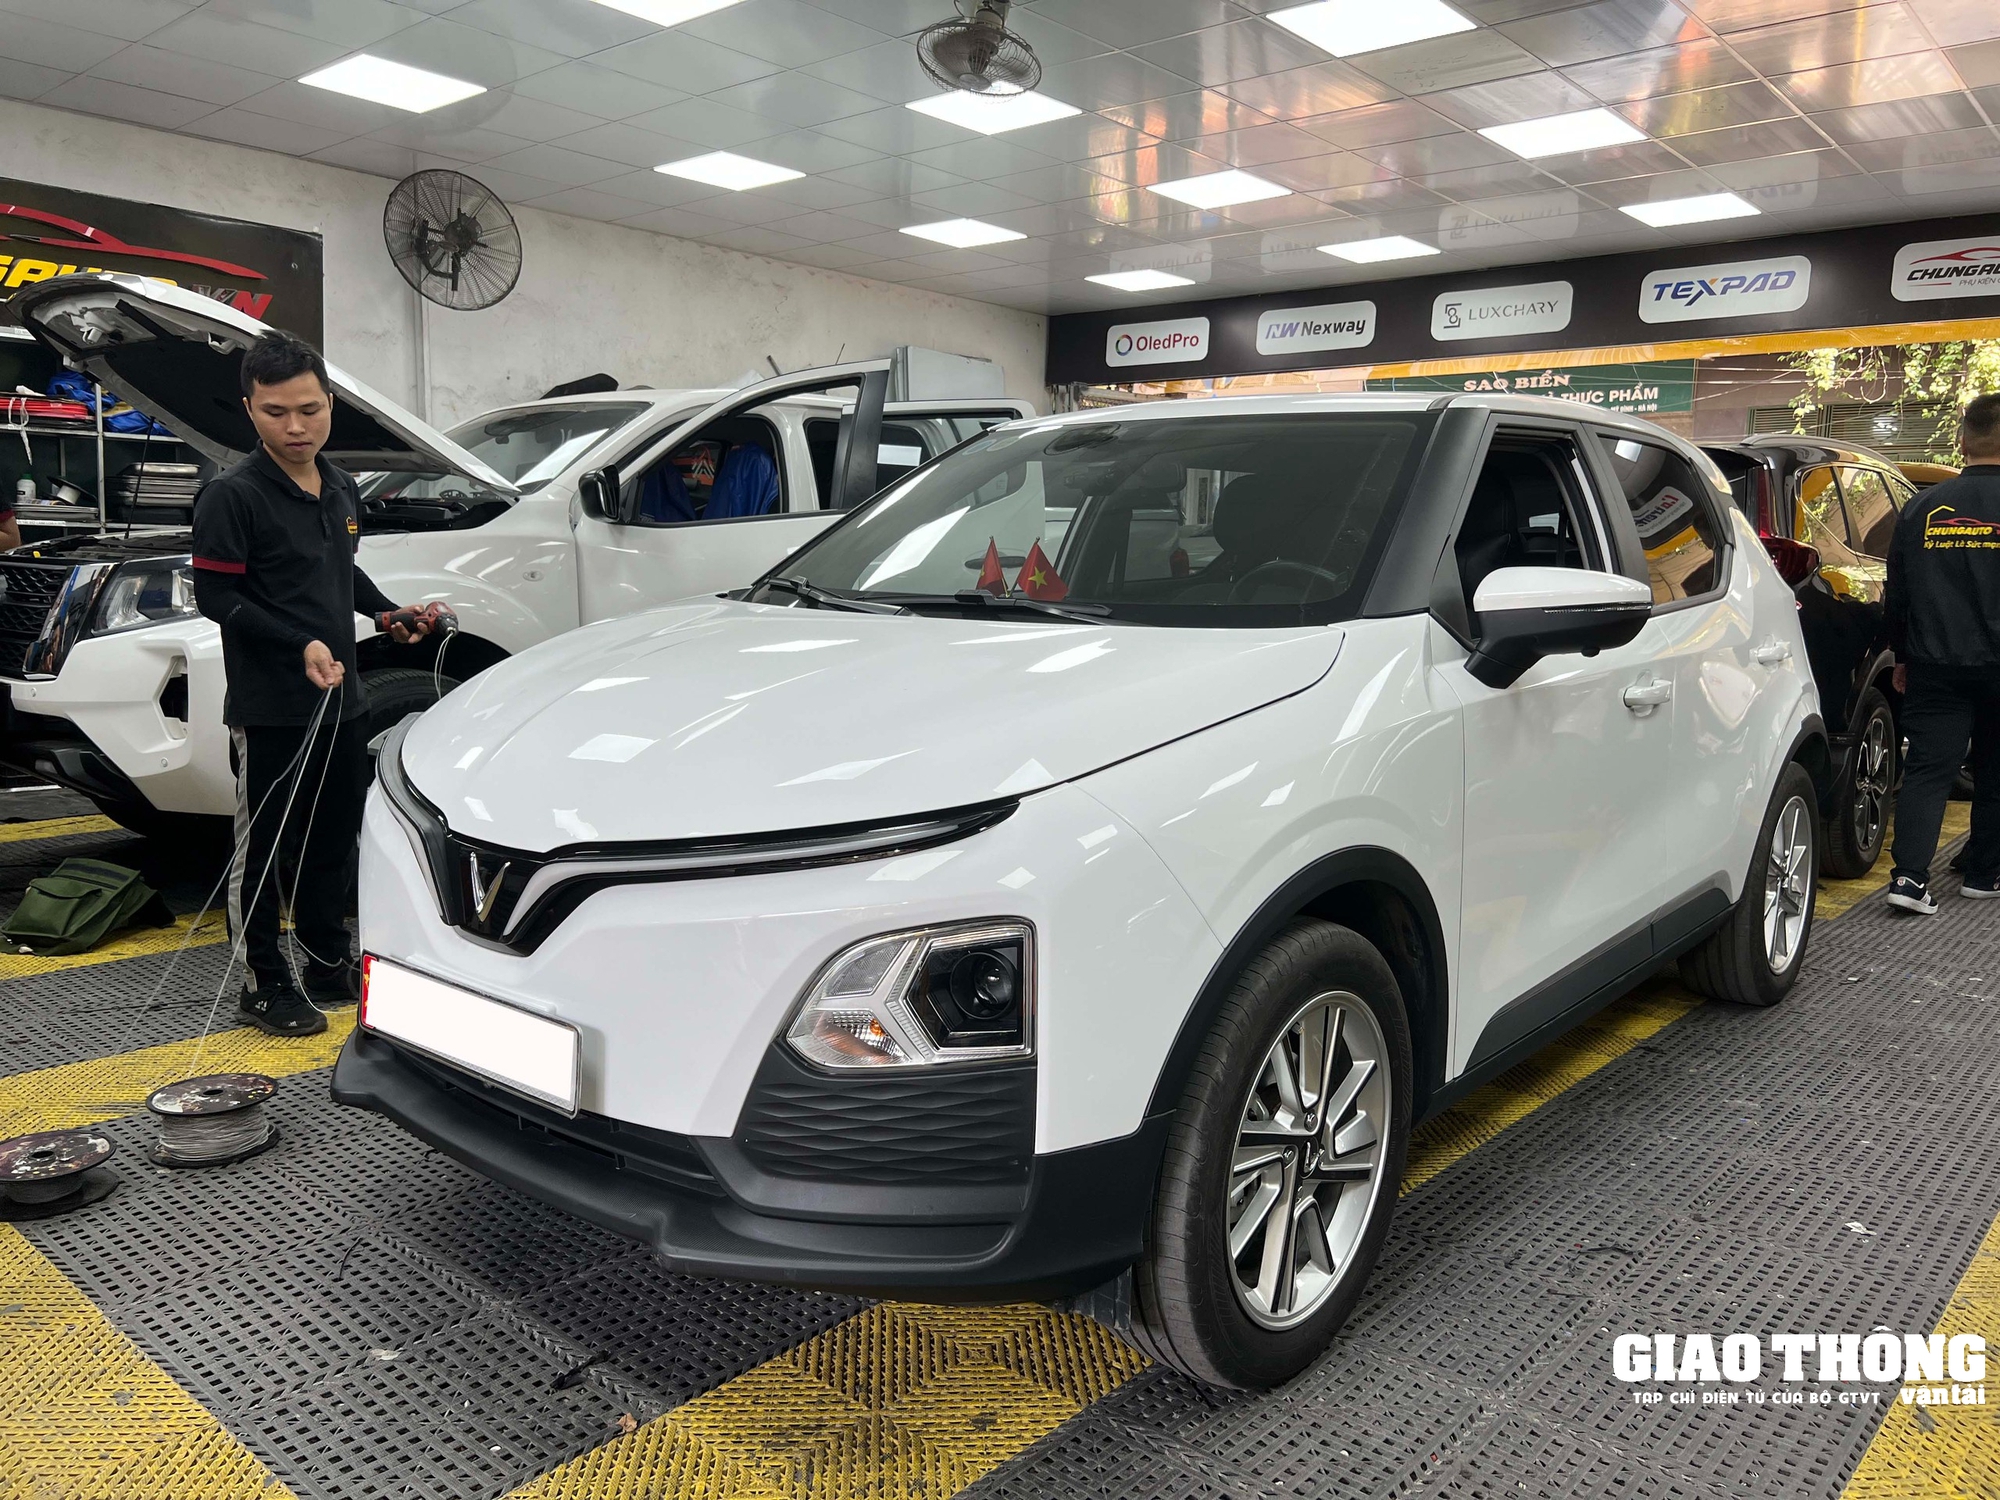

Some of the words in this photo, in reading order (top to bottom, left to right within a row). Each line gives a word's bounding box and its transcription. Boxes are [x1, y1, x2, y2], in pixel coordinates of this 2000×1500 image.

[1653, 270, 1797, 307] TEXPAD
[1468, 300, 1559, 321] LUXCHARY
[1300, 319, 1367, 337] Nexway
[1136, 332, 1200, 352] OledPro
[1464, 378, 1509, 392] SAO
[1927, 526, 1993, 536] CHUNGAUTO
